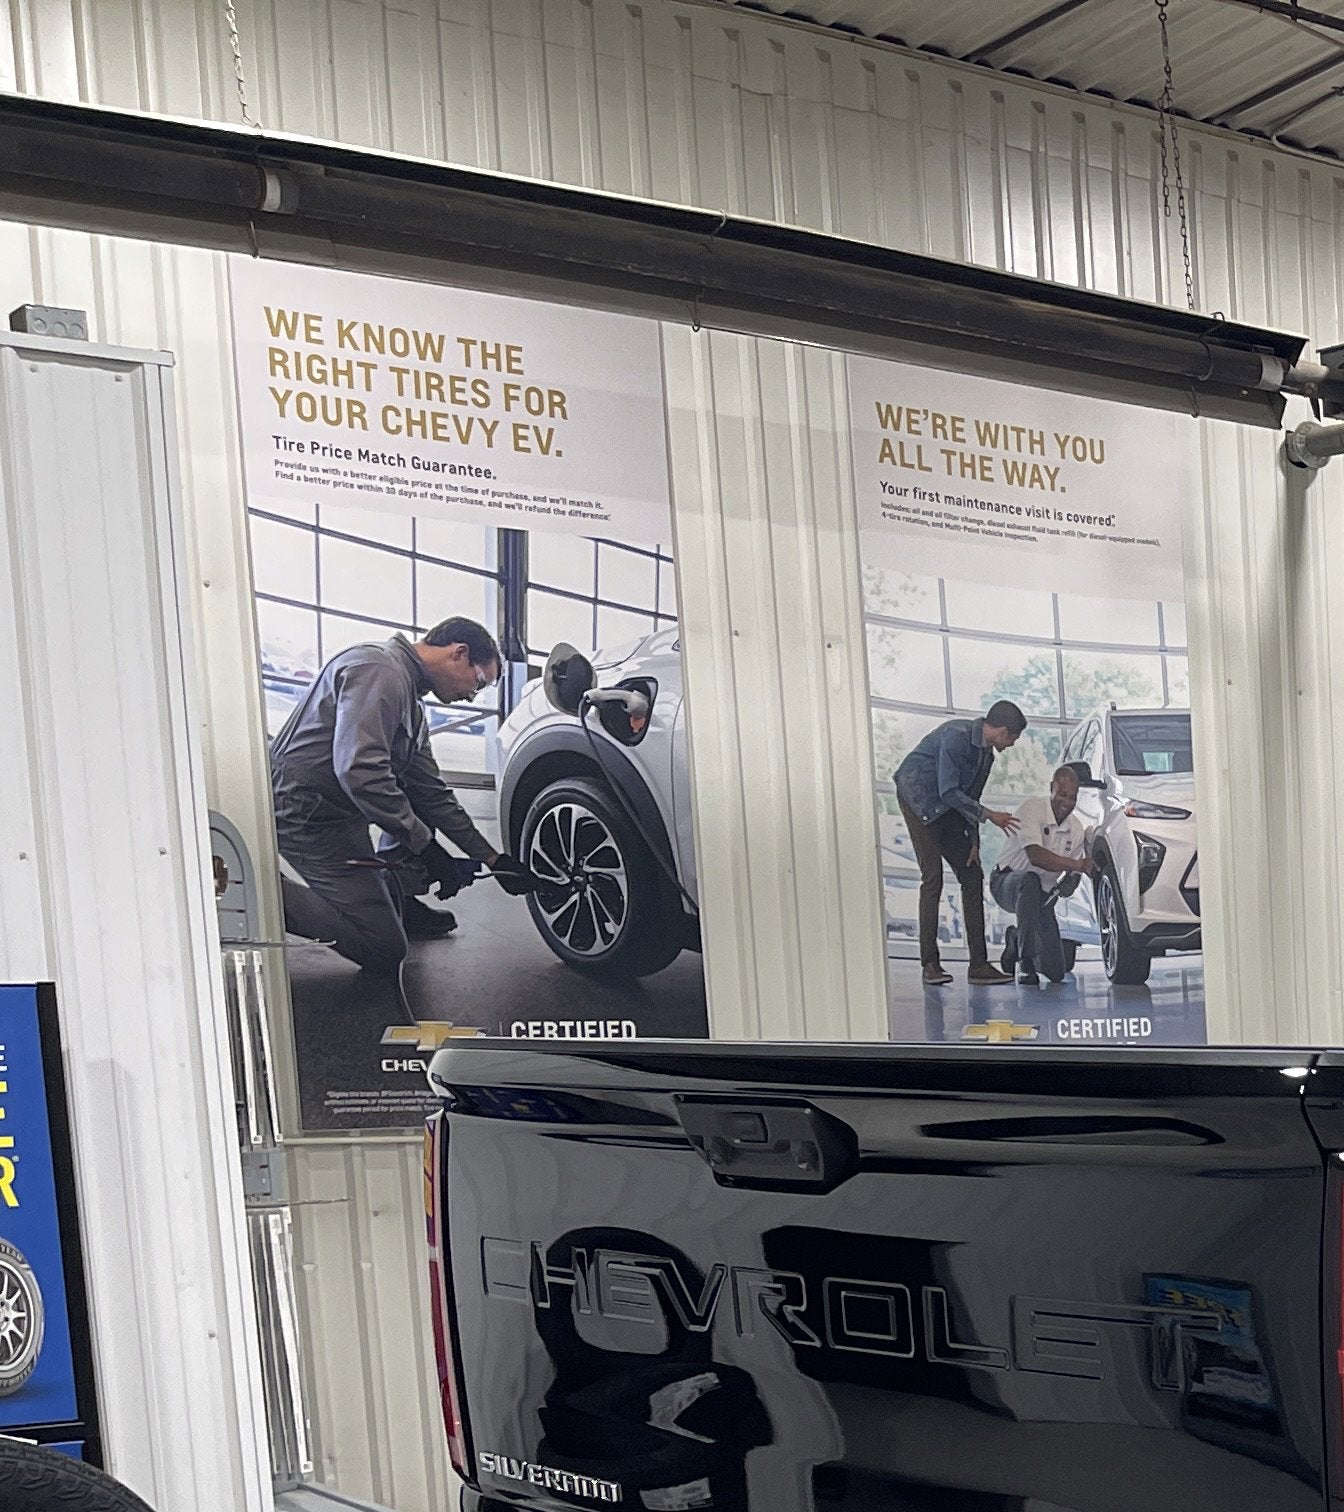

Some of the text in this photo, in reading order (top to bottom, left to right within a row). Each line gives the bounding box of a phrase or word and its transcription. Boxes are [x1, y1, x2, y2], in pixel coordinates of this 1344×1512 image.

[264, 306, 524, 375] WE KNOW THE
[268, 346, 568, 420] RIGHT TIRES FOR
[268, 387, 563, 457] YOUR CHEVY EV.
[974, 420, 1045, 456] WITH
[1054, 432, 1105, 464] YOU
[272, 435, 497, 481] Tire Price Match Guarantee.
[878, 438, 1066, 493] ALL THE WAY.
[880, 480, 909, 498] Your
[913, 486, 941, 504] first
[944, 493, 1022, 517] maintenance
[1025, 504, 1050, 522] visit
[1053, 508, 1064, 522] is
[510, 1020, 637, 1038] CERTIFIED
[1057, 1017, 1152, 1039] CERTIFIED
[482, 1235, 1224, 1396] CHEVROLET
[479, 1452, 622, 1503] SILVERADO
